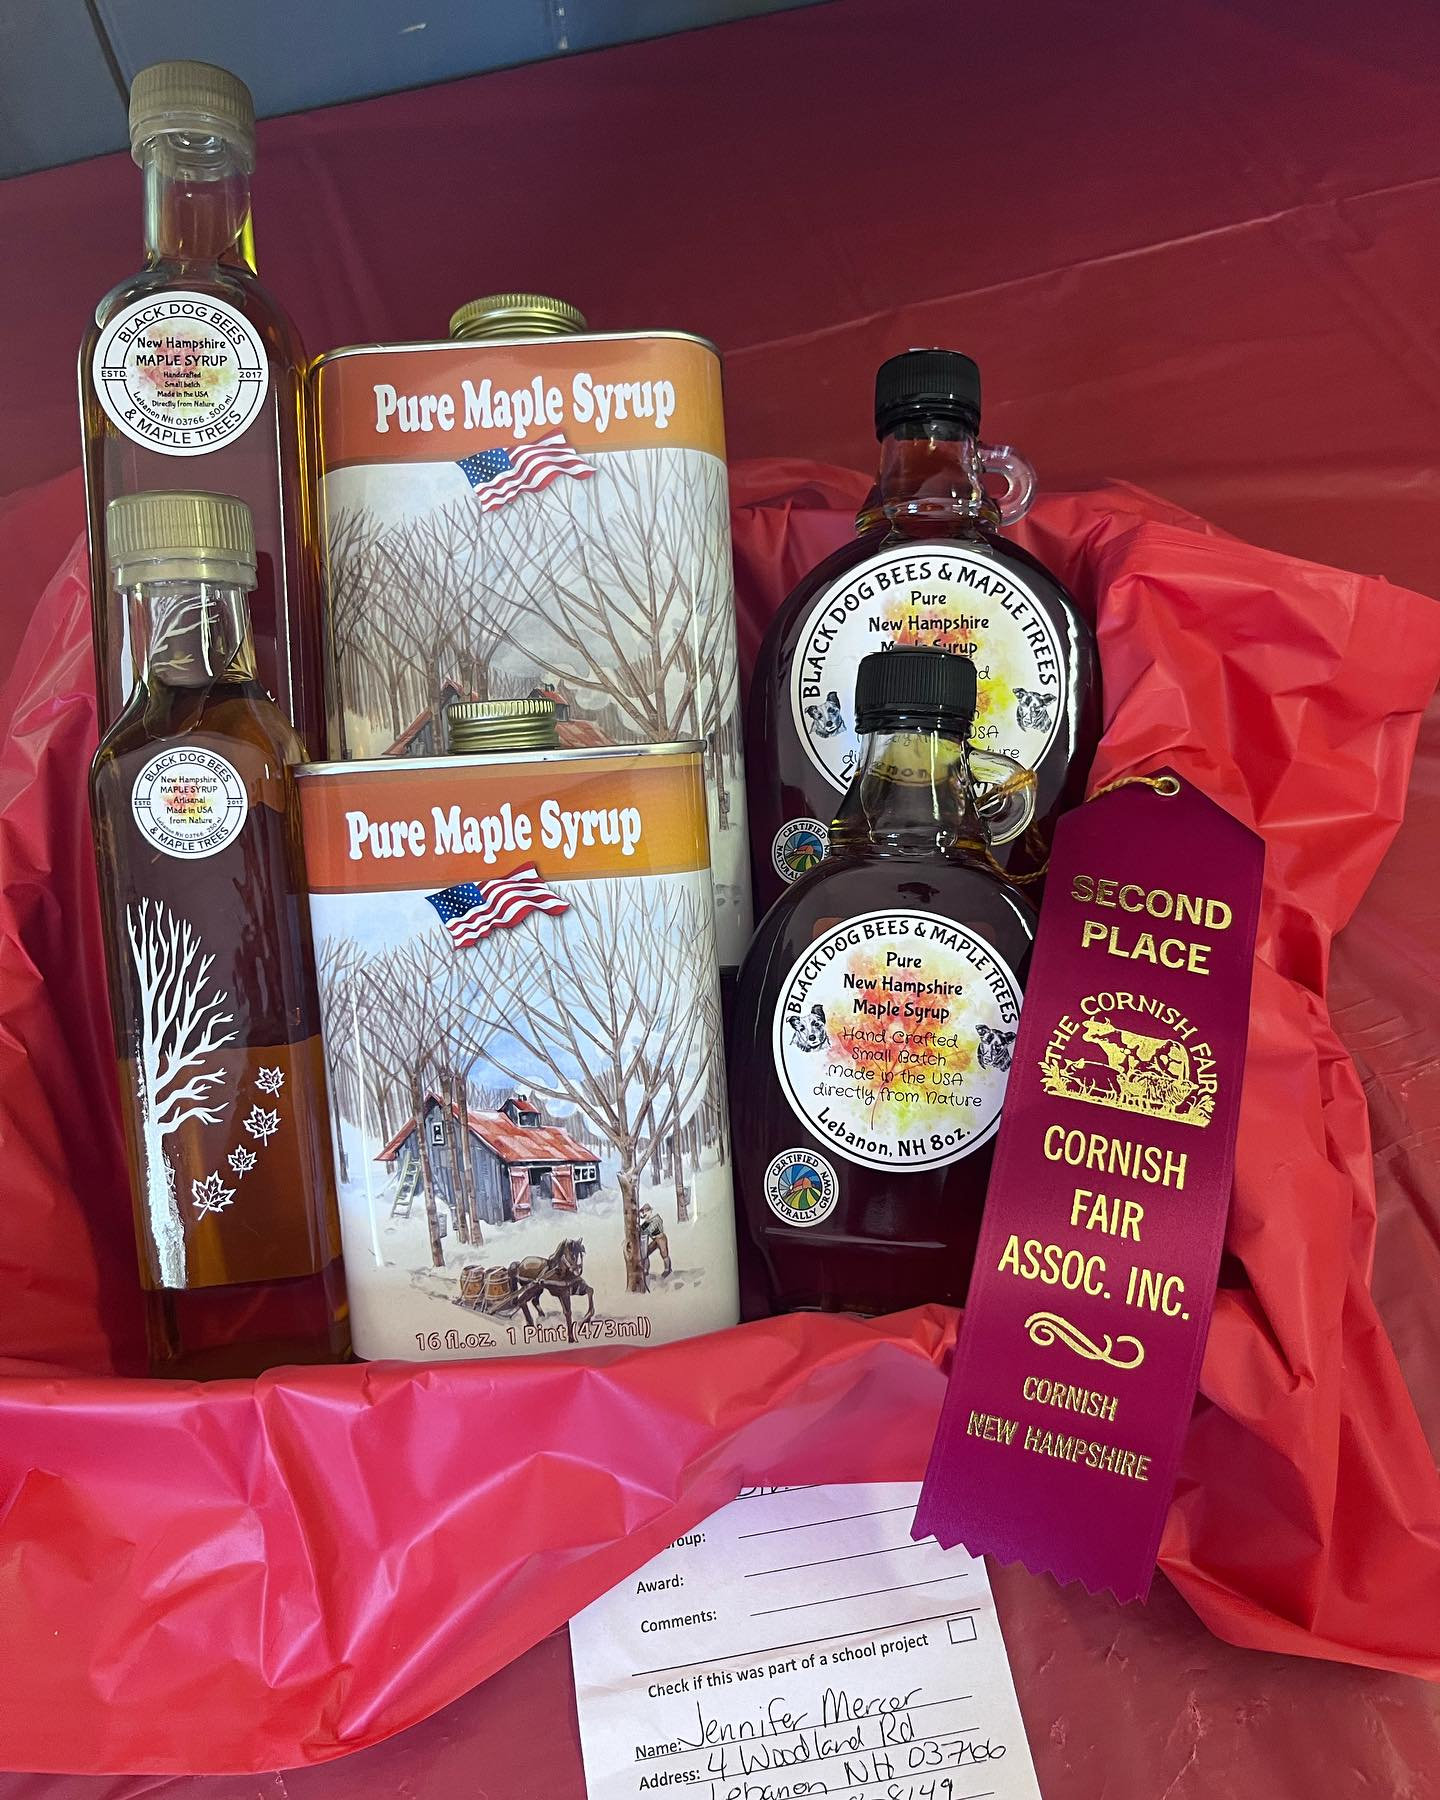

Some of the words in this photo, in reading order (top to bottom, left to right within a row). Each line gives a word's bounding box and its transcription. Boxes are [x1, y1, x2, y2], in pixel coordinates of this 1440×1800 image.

[118, 306, 165, 343] BLACK
[169, 303, 208, 318] DOG
[210, 312, 246, 346] BEES
[138, 337, 162, 348] New
[166, 337, 226, 351] Hampshire
[136, 355, 181, 366] MAPLE
[185, 355, 227, 366] SYRUP
[239, 371, 262, 379] 2017
[133, 391, 160, 419] Lebanon
[161, 414, 174, 424] NH
[176, 416, 205, 425] 03766
[209, 403, 226, 418] 500
[151, 400, 176, 409] Directly
[373, 384, 455, 433] Pure
[461, 376, 564, 438] Maple
[572, 372, 676, 433] Syrup
[125, 409, 137, 420] &
[137, 418, 191, 444] MAPLE
[195, 410, 242, 443] TREES
[910, 591, 947, 606] Pure
[802, 625, 839, 699] BLACK
[829, 582, 875, 625] DOG
[874, 561, 932, 591] BEES
[938, 563, 952, 581] &
[957, 566, 1029, 620] MAPLE
[1022, 617, 1057, 686] TREES
[869, 616, 903, 632] New
[909, 614, 989, 634] Hampshire
[145, 755, 177, 782] BLACK
[180, 753, 205, 764] DOG
[207, 759, 232, 782] BEES
[179, 776, 217, 784] Hampshire
[166, 806, 187, 814] Made
[188, 806, 195, 814] in
[197, 805, 213, 814] USA
[169, 816, 187, 824] from
[188, 816, 213, 824] Nature
[149, 826, 159, 835] &
[158, 833, 195, 851] MAPLE
[197, 827, 229, 849] TREES
[345, 811, 426, 860] Pure
[431, 802, 533, 864] Maple
[540, 800, 642, 859] Syrup
[783, 823, 826, 839] CERTIFIED
[1071, 874, 1232, 930] SECOND
[886, 951, 922, 969] Pure
[1081, 921, 1212, 976] PLACE
[787, 959, 826, 1013] BLACK
[821, 930, 861, 962] DOG
[863, 920, 909, 940] BEES
[914, 922, 926, 937] &
[930, 926, 989, 971] MAPLE
[985, 967, 1018, 1024] TREES
[843, 973, 876, 990] New
[882, 976, 963, 995] Hampshire
[853, 998, 899, 1019] Maple
[904, 1003, 950, 1024] Syrup
[842, 1026, 886, 1043] Hand
[892, 1030, 959, 1049] Crafted
[1045, 1015, 1080, 1061] THE
[1080, 992, 1198, 1040] CORNISH
[1189, 1042, 1218, 1096] FAIR
[852, 1046, 891, 1062] Small
[898, 1050, 946, 1066] Batch
[881, 1072, 894, 1083] in
[900, 1070, 926, 1084] the
[932, 1072, 964, 1086] USA
[813, 1082, 875, 1106] directly
[880, 1087, 919, 1102] from
[817, 1107, 893, 1157] Lebanon,
[899, 1139, 924, 1157] NH
[930, 1127, 971, 1151] 8oz.
[772, 1154, 819, 1176] CERTIFIED
[1044, 1125, 1187, 1190] CORNISH
[770, 1186, 817, 1219] NATURALLY
[819, 1171, 832, 1209] GROWN
[1070, 1188, 1145, 1242] FAIR
[997, 1235, 1111, 1299] ASSOC.
[1126, 1267, 1190, 1321] INC.
[416, 1332, 442, 1351] 16
[446, 1329, 497, 1350] fl.oz.
[507, 1327, 517, 1345] 1
[524, 1324, 568, 1344] Pint
[572, 1316, 652, 1344] (473ml)
[1023, 1376, 1119, 1422] CORNISH
[967, 1411, 1019, 1445] NEW
[1024, 1425, 1152, 1482] HAMPSHIRE
[636, 1574, 684, 1595] Award:
[640, 1609, 718, 1634] Comments:
[648, 1679, 690, 1699] Check
[692, 1674, 703, 1690] if
[706, 1670, 733, 1688] this
[736, 1667, 765, 1682] was
[768, 1658, 797, 1679] part
[801, 1652, 816, 1669] of
[819, 1655, 828, 1666] a
[832, 1642, 878, 1665] school
[880, 1632, 930, 1658] project
[678, 1697, 808, 1748] Jennifer
[822, 1687, 924, 1728] Mercer
[635, 1739, 683, 1760] Name:
[707, 1747, 727, 1781] 4
[739, 1725, 865, 1776] Woodland
[879, 1711, 916, 1748] Rd
[639, 1768, 701, 1792] Address:
[844, 1753, 895, 1786] NH
